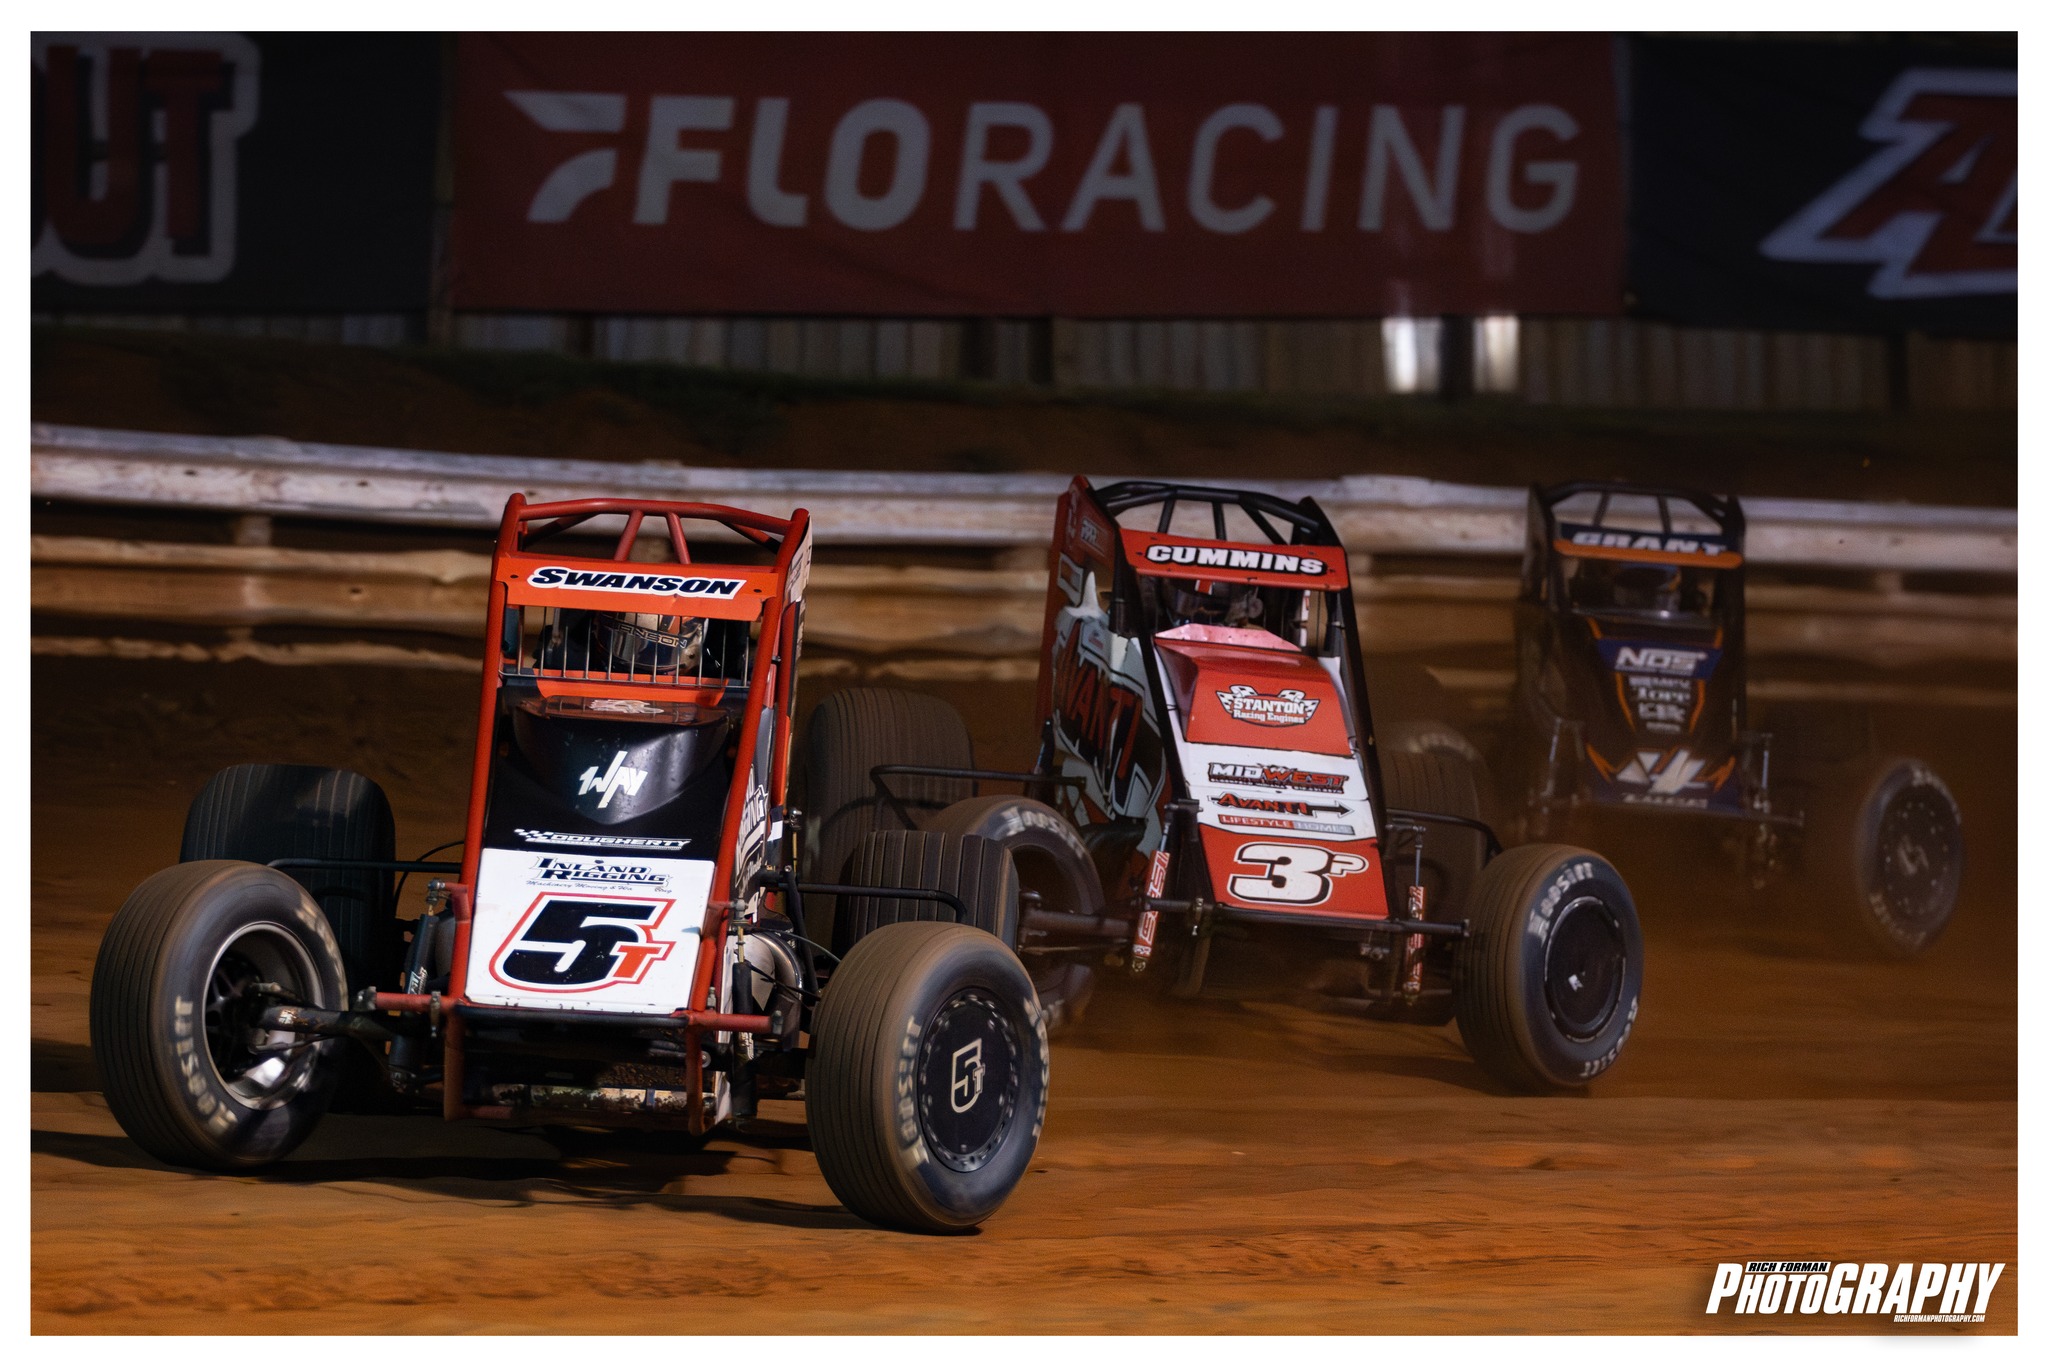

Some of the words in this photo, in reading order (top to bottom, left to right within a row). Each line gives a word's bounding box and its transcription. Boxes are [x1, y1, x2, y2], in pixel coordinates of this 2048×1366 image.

[31, 44, 236, 258] UT
[1571, 531, 1727, 557] GRANT
[1146, 545, 1327, 576] CUMMINS
[531, 568, 740, 595] SWANSON
[1616, 645, 1700, 672] NOS
[1233, 697, 1305, 715] STANTON
[1233, 709, 1266, 722] Racing
[1267, 711, 1305, 724] Engines
[1209, 762, 1346, 787] MIDWEST
[1217, 792, 1308, 815] AVANTI
[1220, 815, 1292, 828] LIFESTYLE
[550, 834, 691, 847] DOUGHERTY
[538, 858, 648, 874] INLAND
[541, 869, 668, 882] RIGGING
[1228, 841, 1368, 906] 3P
[496, 896, 669, 989] 5T
